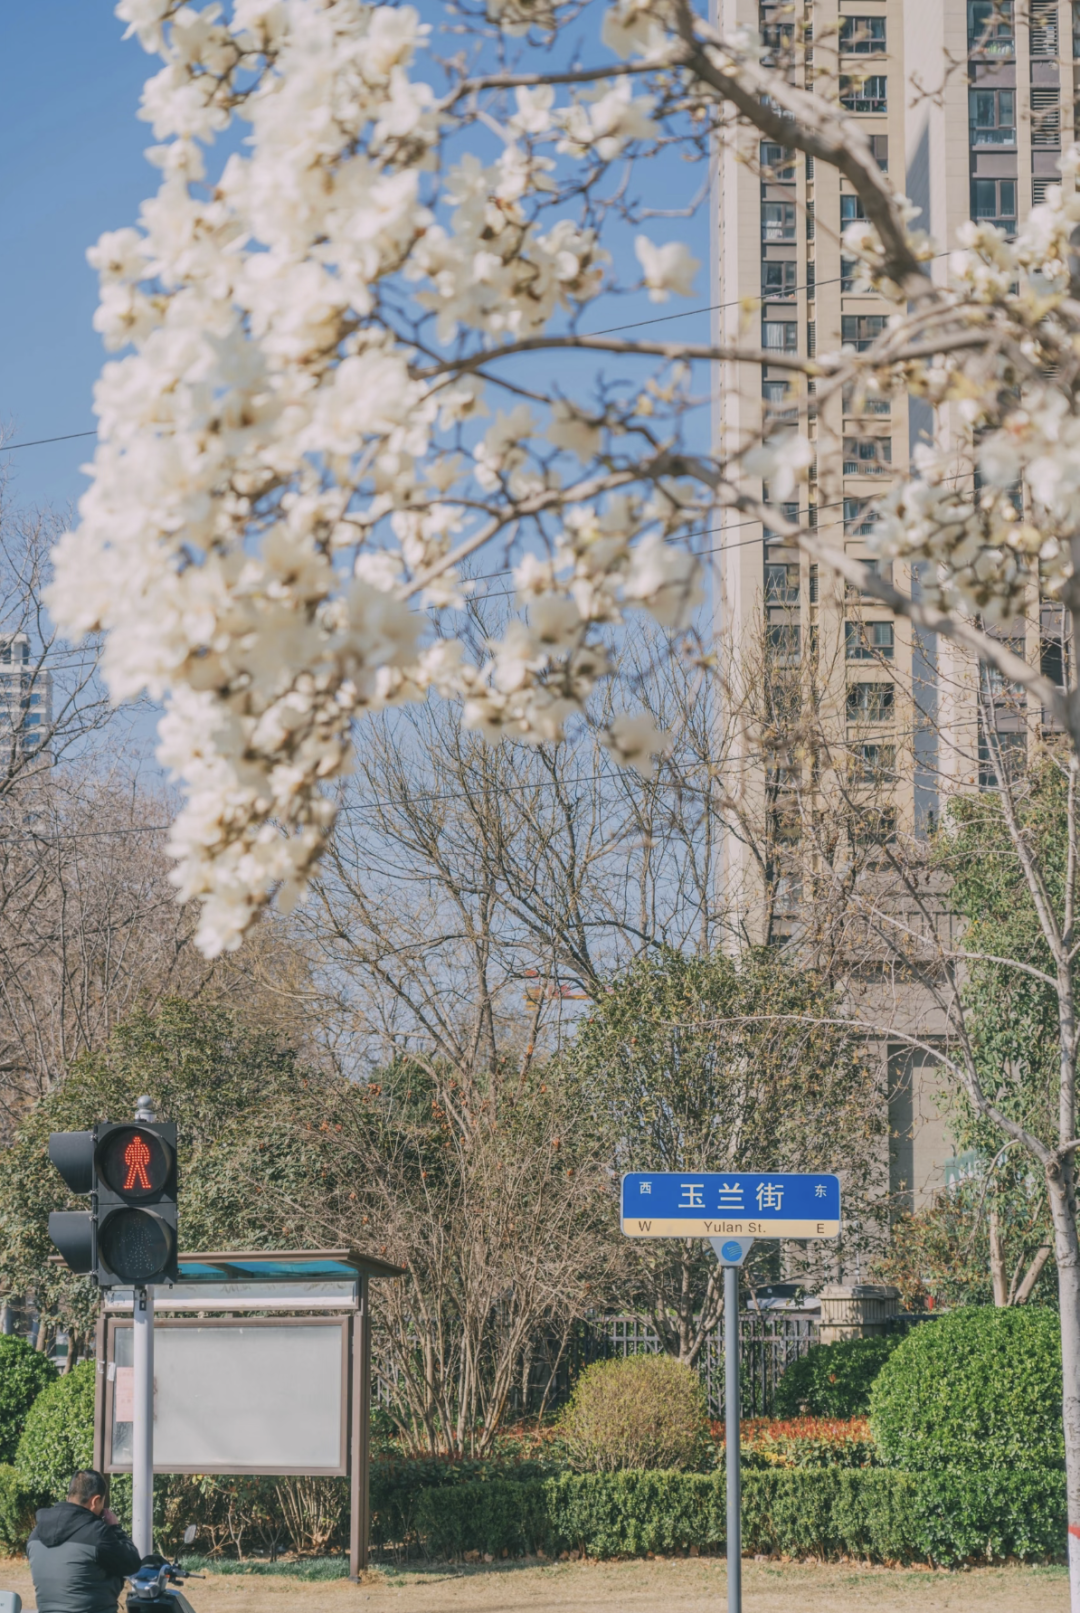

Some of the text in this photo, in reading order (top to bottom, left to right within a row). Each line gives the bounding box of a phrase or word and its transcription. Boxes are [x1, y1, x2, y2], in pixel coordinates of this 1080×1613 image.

[639, 1182, 652, 1194] 西
[815, 1184, 827, 1198] 东
[678, 1182, 784, 1211] 玉兰街
[638, 1221, 652, 1232] W
[703, 1221, 766, 1233] Yulan St.
[816, 1223, 825, 1234] E
